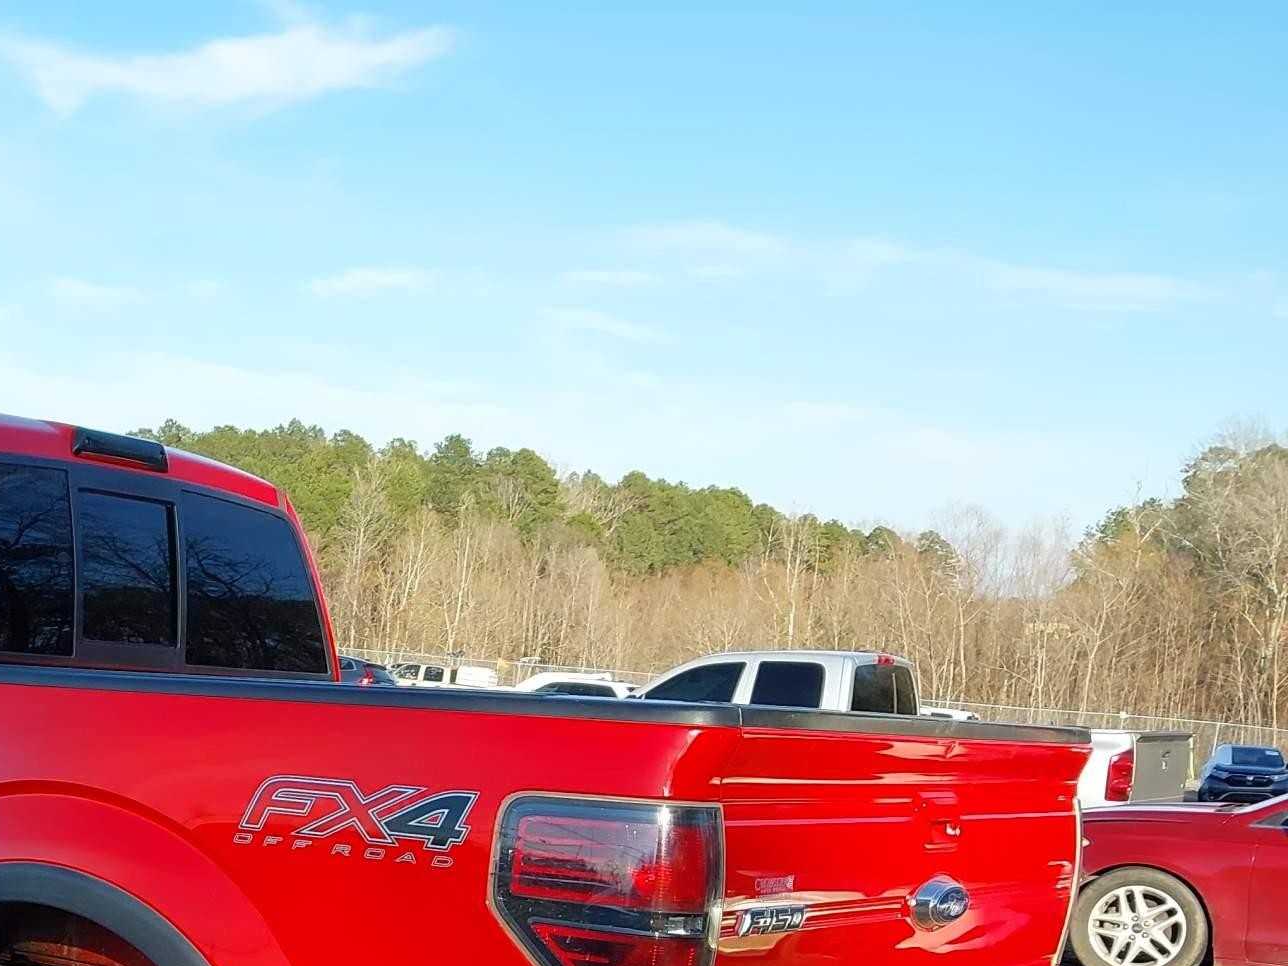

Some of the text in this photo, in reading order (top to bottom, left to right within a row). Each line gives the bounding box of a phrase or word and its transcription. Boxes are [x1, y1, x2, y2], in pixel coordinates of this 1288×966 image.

[238, 775, 480, 852] FX4
[233, 833, 454, 868] OFF ROAD
